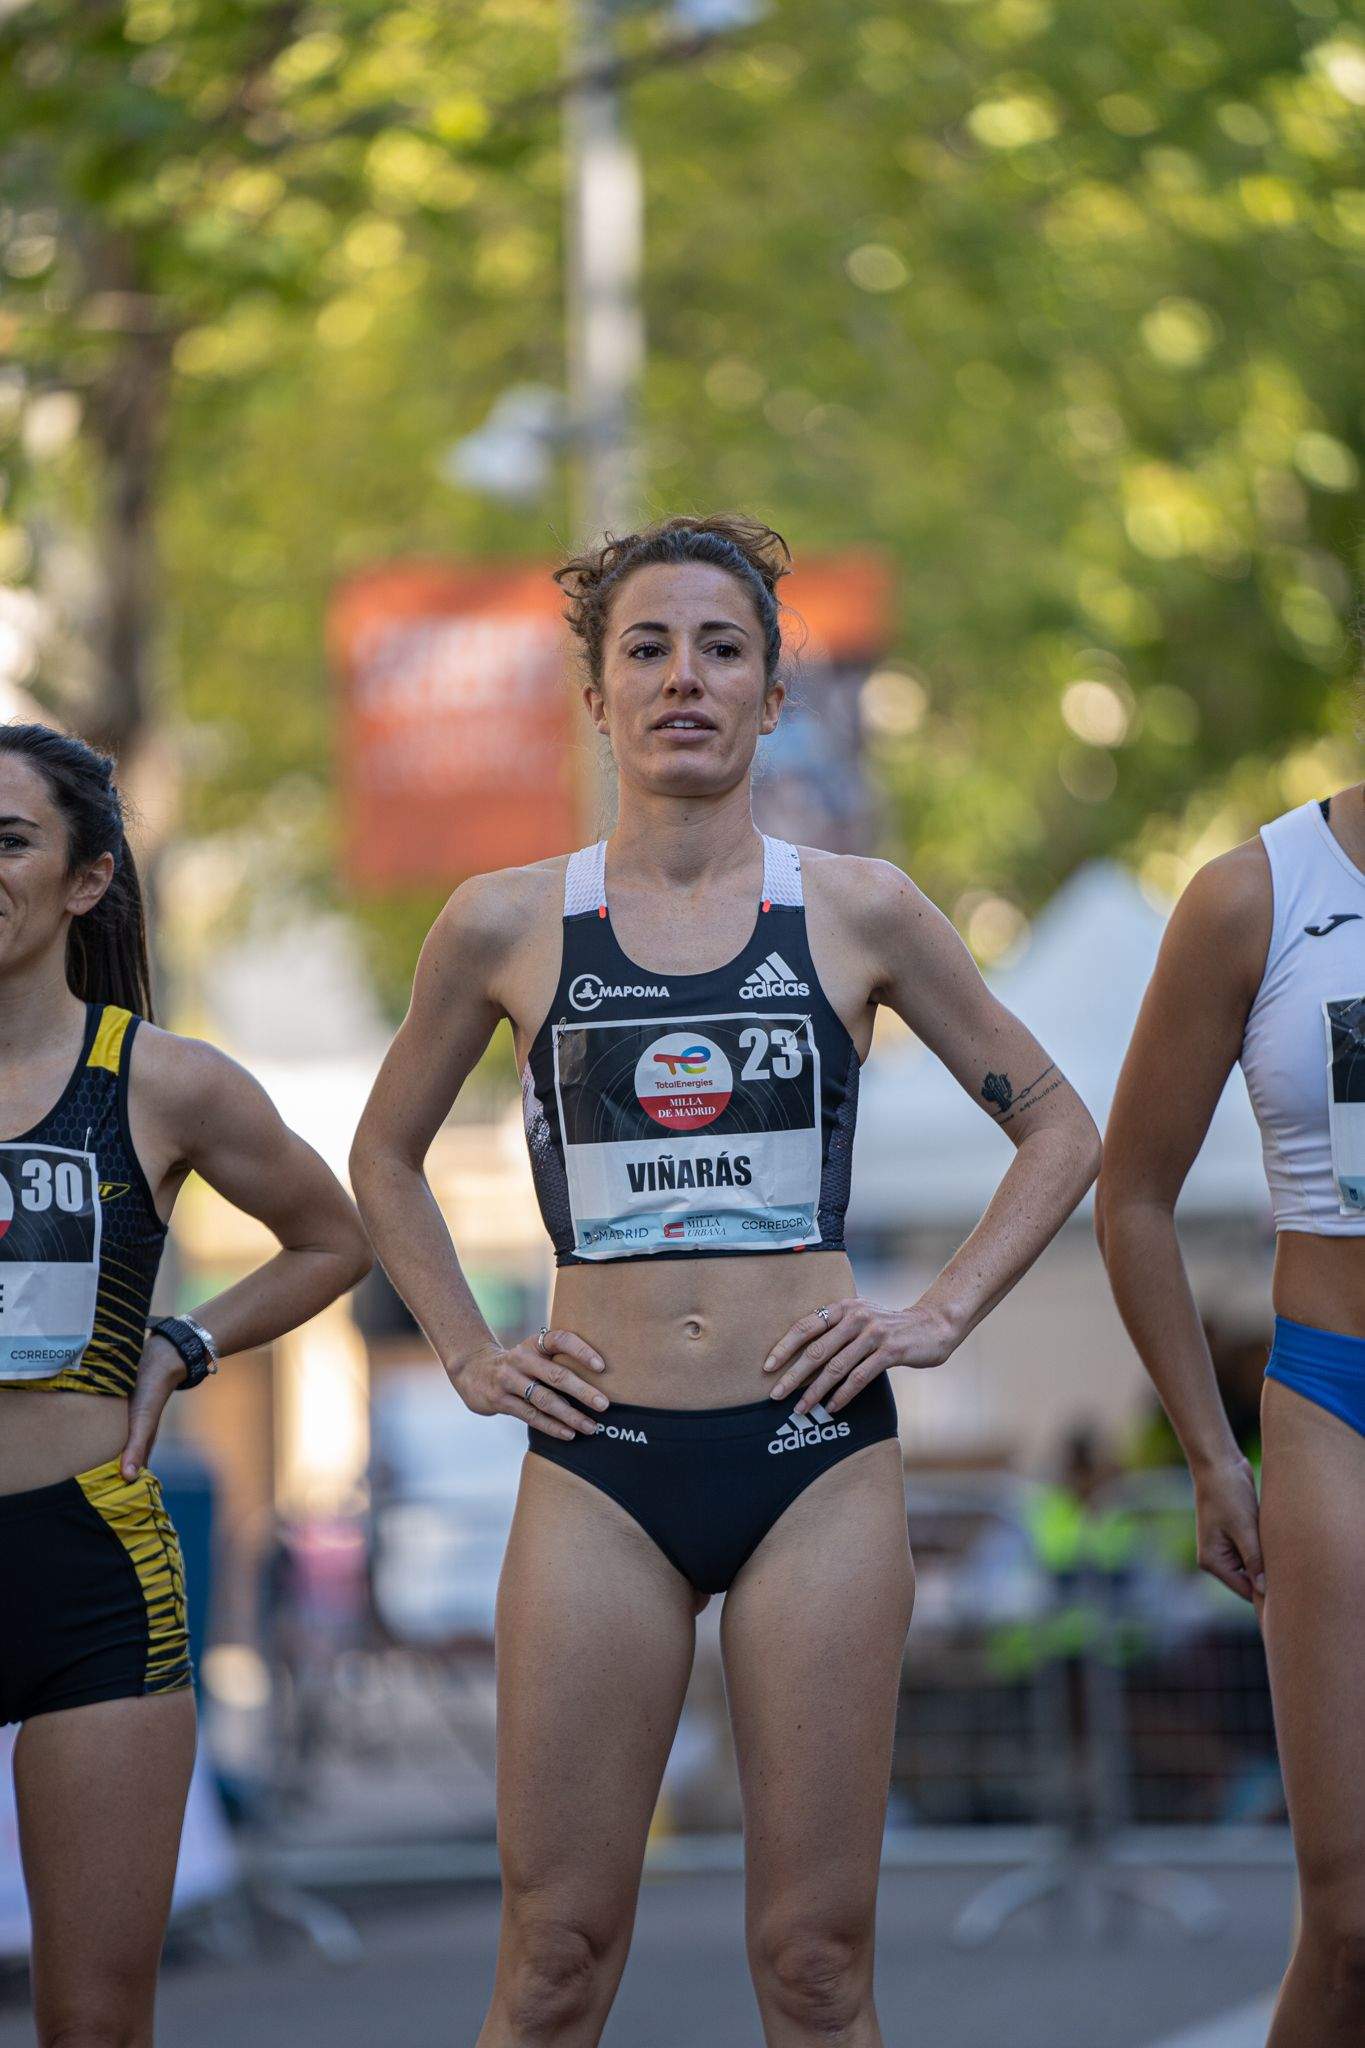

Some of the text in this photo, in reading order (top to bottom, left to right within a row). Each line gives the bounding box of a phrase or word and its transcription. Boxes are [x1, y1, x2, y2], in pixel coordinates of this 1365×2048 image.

[599, 985, 670, 998] MAPOMA
[739, 980, 810, 999] adidas
[739, 1028, 803, 1080] 23
[655, 1079, 713, 1089] TotalEnergies
[670, 1097, 703, 1107] MILLA
[657, 1106, 716, 1118] DE MADRID
[626, 1150, 752, 1192] VIÑARÁS
[21, 1158, 84, 1212] 30
[687, 1218, 720, 1228] MILLA
[599, 1227, 649, 1241] MADRID
[688, 1228, 726, 1237] URBANA
[596, 1423, 648, 1444] POMA
[768, 1422, 851, 1454] adidas
